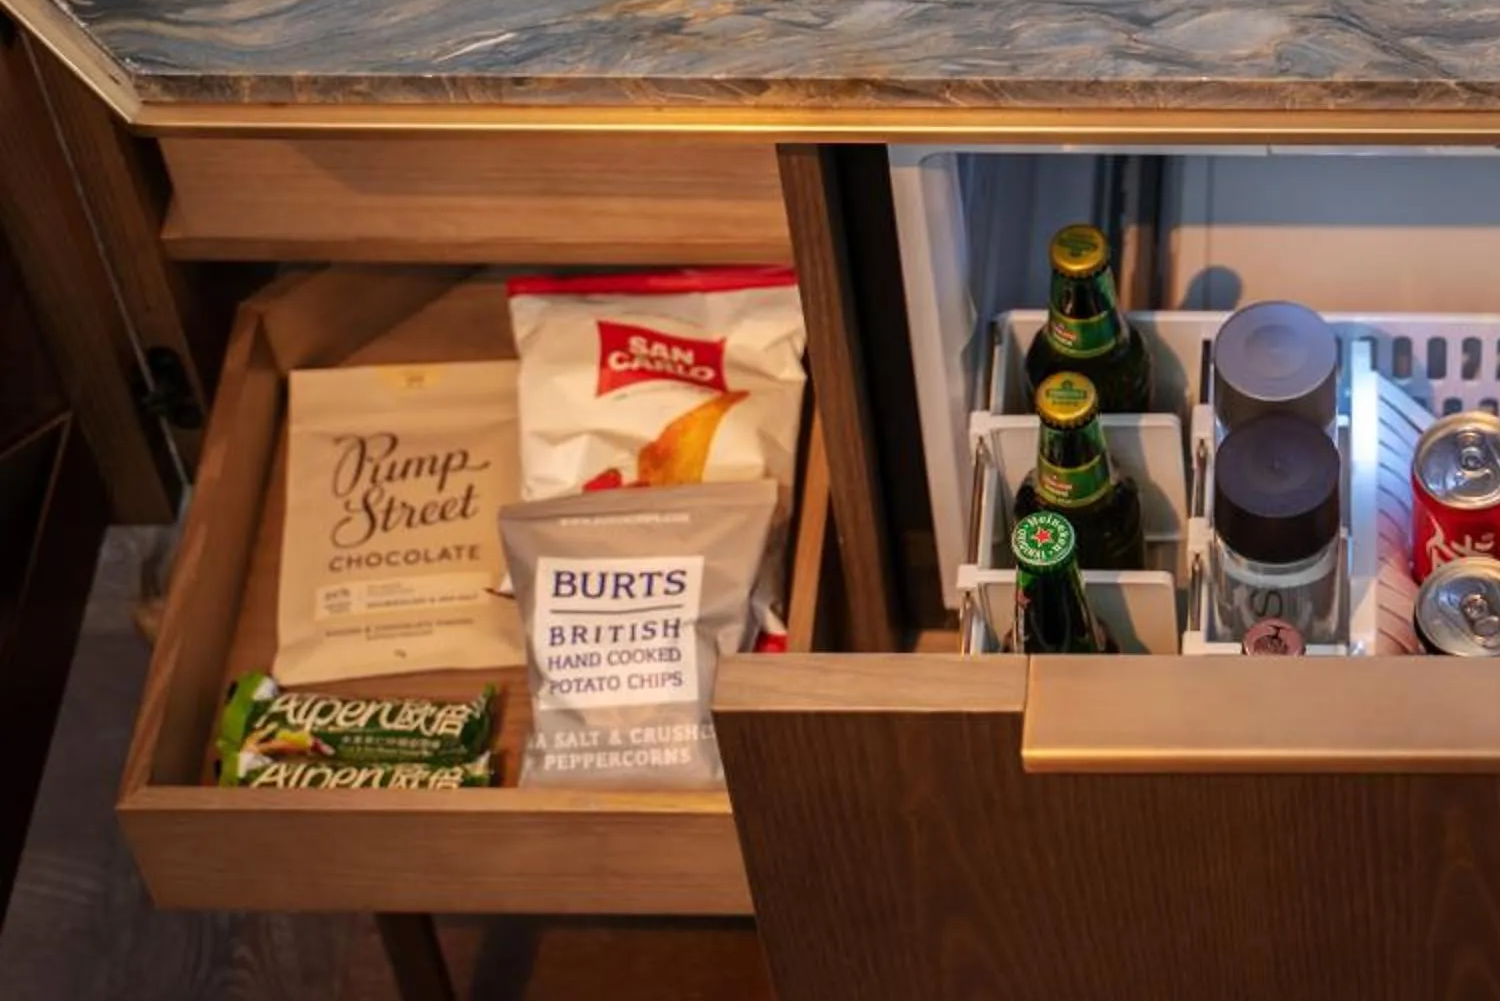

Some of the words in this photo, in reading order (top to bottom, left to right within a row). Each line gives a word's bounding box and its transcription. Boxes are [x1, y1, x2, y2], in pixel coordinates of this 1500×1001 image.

[628, 336, 694, 365] SAN
[608, 350, 716, 381] CARLO
[332, 431, 491, 498] Pump
[330, 483, 480, 549] Street
[328, 545, 481, 572] CHOCOLATE
[551, 569, 688, 599] BURTS
[548, 617, 682, 647] BRITISH
[547, 652, 601, 671] HAND
[606, 647, 682, 667] COOKED
[549, 676, 620, 695] POTATO
[627, 672, 683, 690] CHIPS
[254, 692, 398, 730] Alpen
[553, 731, 600, 749] SALT
[544, 747, 693, 771] PEPPERCORNS
